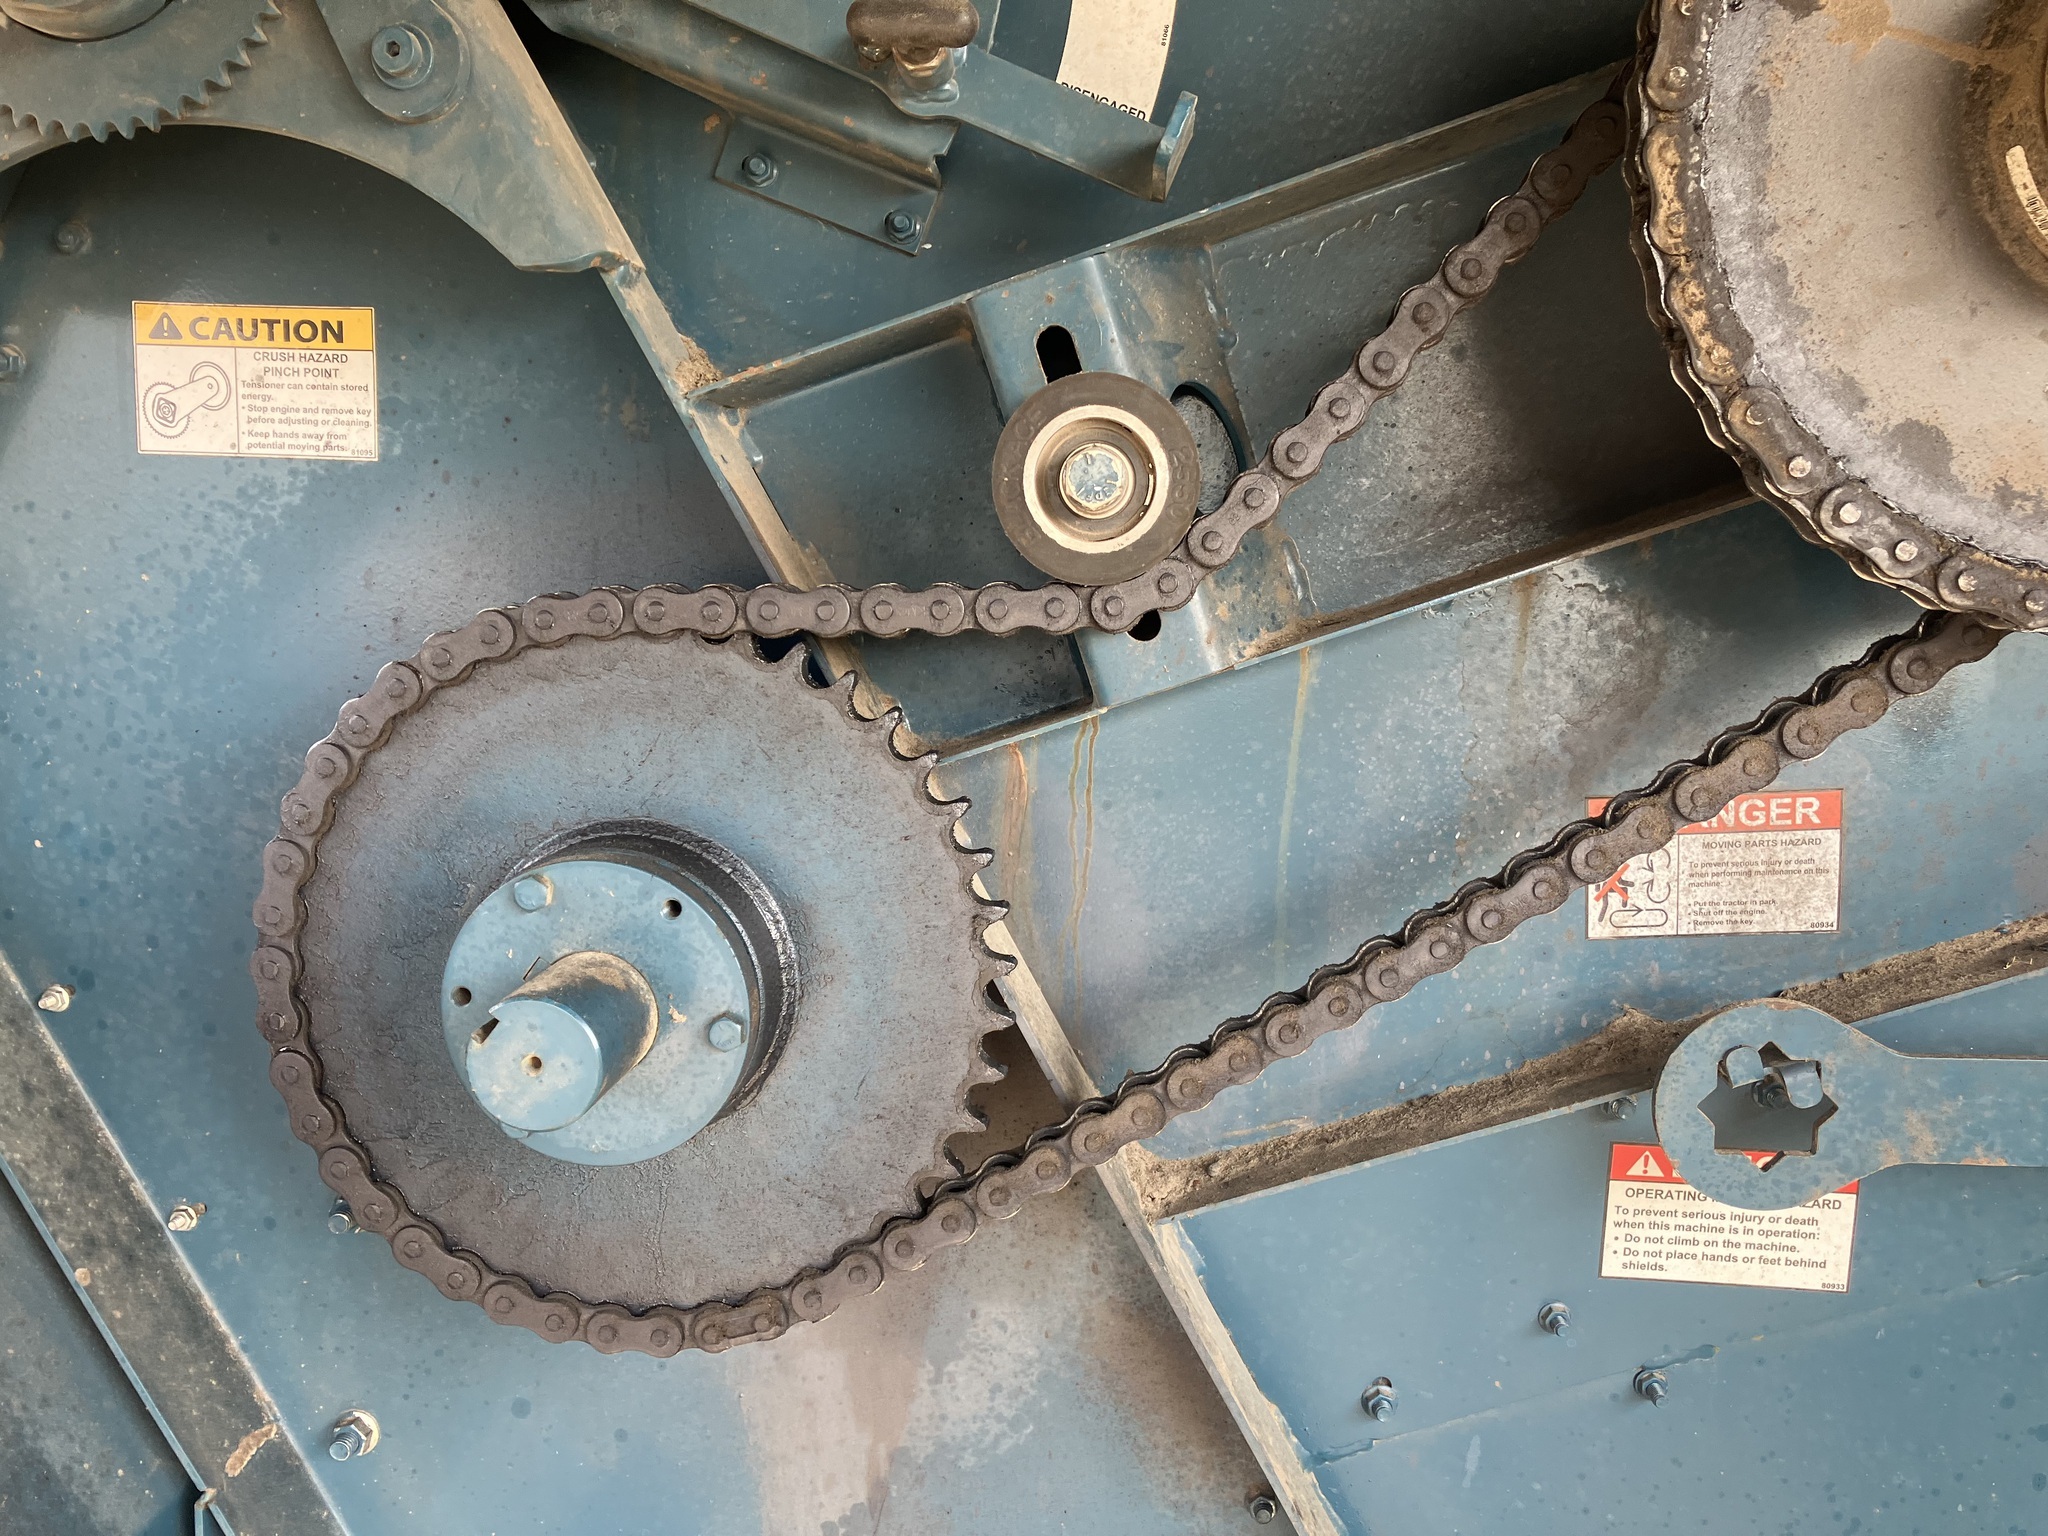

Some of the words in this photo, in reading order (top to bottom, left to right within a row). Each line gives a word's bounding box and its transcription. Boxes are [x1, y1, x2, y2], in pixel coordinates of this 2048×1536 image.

[1161, 24, 1170, 46] 81066
[189, 317, 344, 343] CAUTION
[253, 351, 295, 362] CRUSH
[299, 353, 348, 363] HAZARD
[263, 367, 300, 377] PINCH
[304, 368, 339, 378] POINT
[241, 380, 285, 389] Tensioner
[287, 382, 303, 390] can
[306, 382, 338, 391] contain
[241, 393, 274, 402] energy.
[247, 404, 268, 414] Stop
[270, 405, 300, 415] engine
[302, 406, 319, 414] and
[321, 407, 354, 415] remove
[356, 407, 372, 417] key
[247, 415, 275, 424] before
[277, 416, 318, 427] adjusting
[332, 418, 372, 428] cleaning.
[247, 429, 270, 439] Keep
[272, 430, 299, 439] hands
[301, 432, 324, 441] away
[326, 432, 347, 441] from
[247, 441, 285, 452] potential
[287, 443, 320, 453] moving
[322, 444, 348, 453] parts.
[1700, 797, 1821, 828] NGER
[1702, 840, 1741, 849] MOVING
[1745, 839, 1778, 848] PARTS
[1780, 837, 1822, 847] HAZARD
[1700, 860, 1729, 869] prevent
[1731, 860, 1759, 868] serious
[1761, 858, 1782, 868] injury
[1794, 858, 1815, 866] death
[1711, 869, 1752, 879] performing
[1754, 868, 1802, 877] maintenance
[1815, 867, 1830, 875] this
[1713, 909, 1723, 917] off
[1810, 921, 1835, 929] 80934
[1625, 1187, 1707, 1202] OPERATING
[1614, 1205, 1629, 1215] To
[1633, 1208, 1678, 1218] prevent
[1681, 1210, 1726, 1220] serious
[1730, 1211, 1765, 1225] injury
[1768, 1215, 1782, 1224] or
[1784, 1215, 1819, 1227] death
[1613, 1219, 1645, 1229] when
[1648, 1220, 1670, 1231] this
[1674, 1222, 1725, 1234] machine
[1728, 1225, 1739, 1235] is
[1743, 1226, 1754, 1236] in
[1757, 1228, 1820, 1240] operation:
[1624, 1233, 1641, 1243] Do
[1644, 1235, 1664, 1245] not
[1667, 1236, 1700, 1247] climb
[1703, 1239, 1719, 1248] on
[1722, 1239, 1741, 1249] the
[1745, 1241, 1800, 1253] machine.
[1623, 1247, 1639, 1257] Do
[1643, 1249, 1663, 1258] not
[1665, 1249, 1698, 1261] place
[1701, 1251, 1738, 1263] hands
[1742, 1256, 1755, 1264] or
[1758, 1255, 1781, 1266] feet
[1784, 1256, 1827, 1269] behind
[1621, 1261, 1668, 1272] shields.
